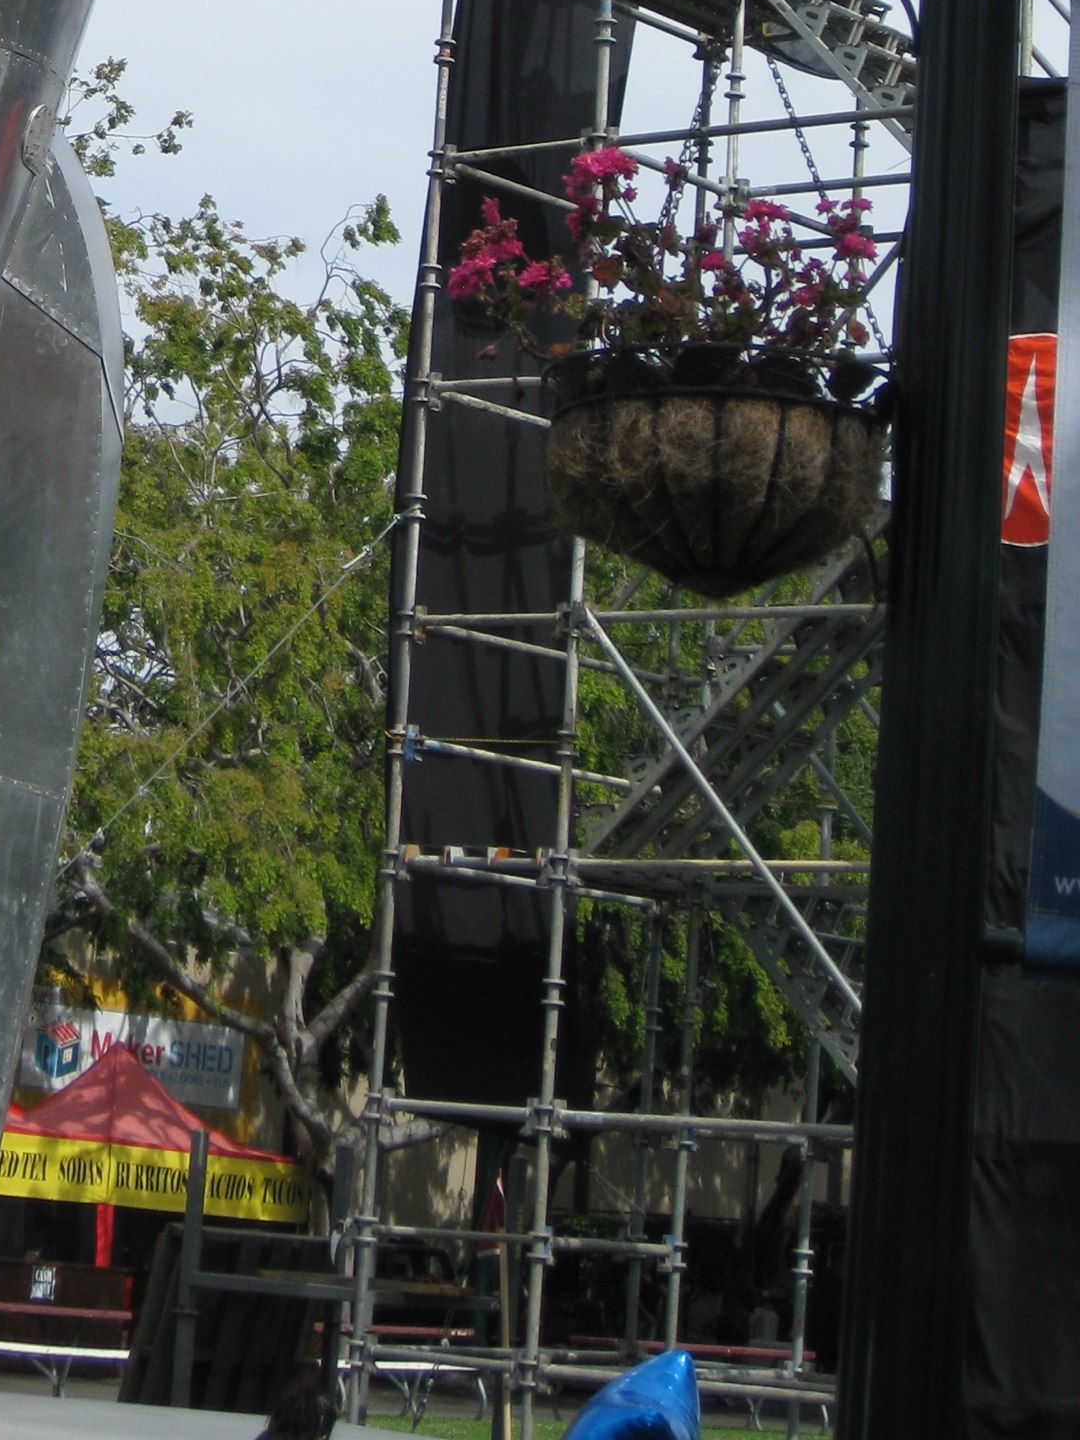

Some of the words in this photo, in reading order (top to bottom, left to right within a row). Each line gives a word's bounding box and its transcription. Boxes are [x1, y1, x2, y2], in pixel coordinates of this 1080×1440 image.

[90, 1029, 166, 1066] Mker
[168, 1040, 234, 1074] SHED
[57, 1155, 104, 1187] SODAS
[115, 1161, 188, 1194] BURRITOS
[206, 1171, 254, 1202] ACHOS
[262, 1177, 304, 1207] TACOS
